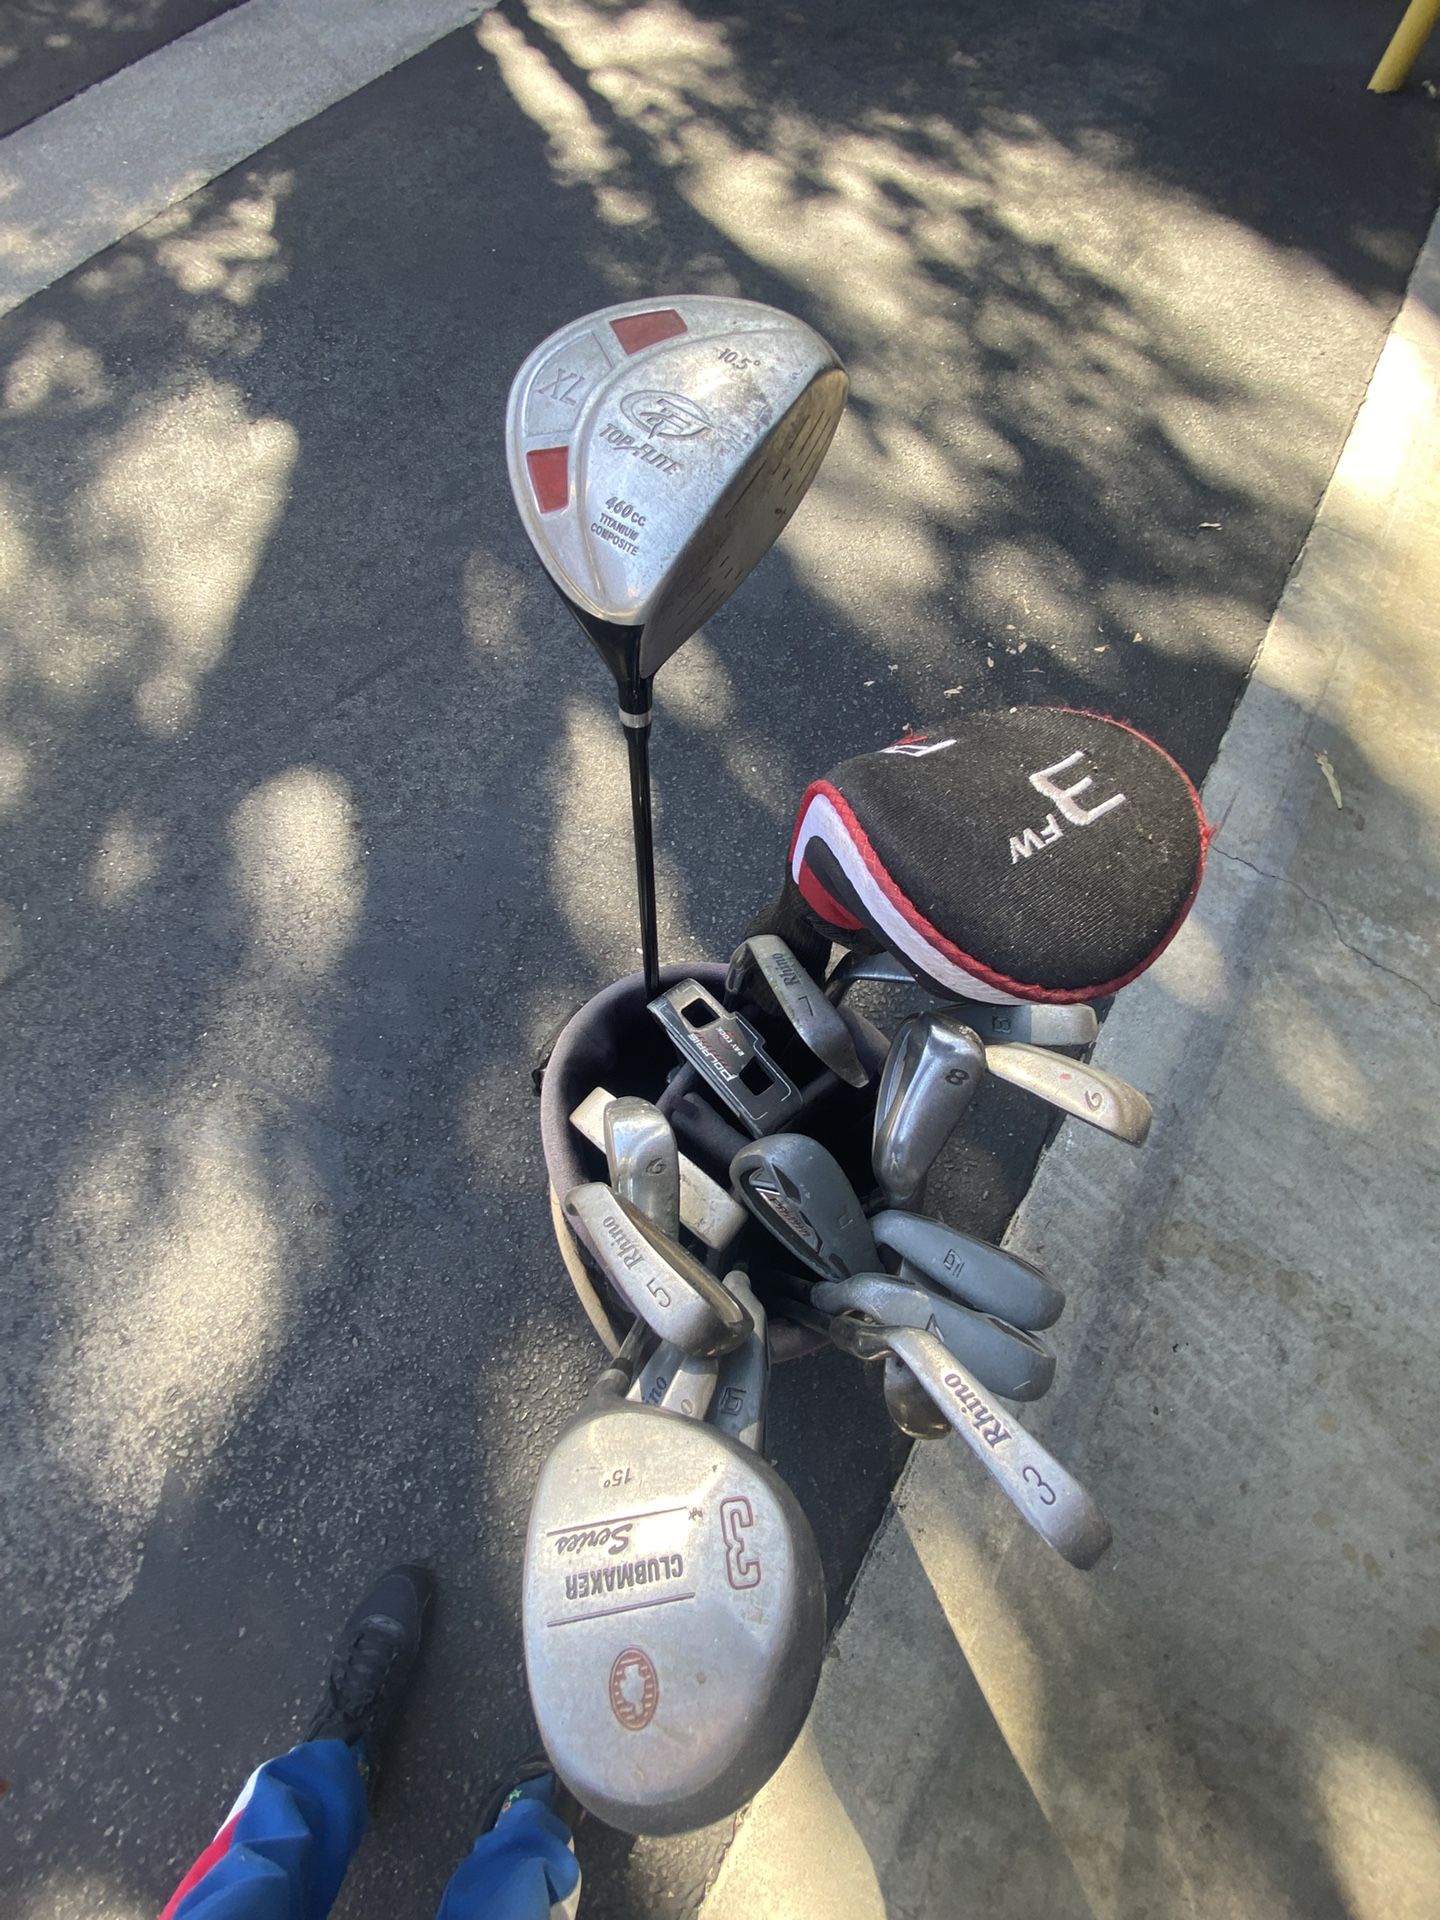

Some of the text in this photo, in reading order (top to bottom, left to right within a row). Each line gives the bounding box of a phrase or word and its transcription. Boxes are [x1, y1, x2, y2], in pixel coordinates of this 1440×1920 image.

[538, 368, 585, 406] XL
[590, 522, 640, 556] COMPOSITE
[599, 512, 639, 541] TITANIUM
[1009, 751, 1126, 864] 3 FW
[772, 952, 802, 987] Rhino
[688, 1033, 738, 1082] POLARIS
[944, 1068, 969, 1086] 8
[603, 1216, 643, 1270] Rhino
[646, 1278, 672, 1309] 5
[944, 1371, 1013, 1449] Rhino
[1022, 1465, 1056, 1506] 3
[555, 1524, 633, 1555] Series
[719, 1496, 762, 1590] 3
[565, 1554, 684, 1600] CLUBMAKER
